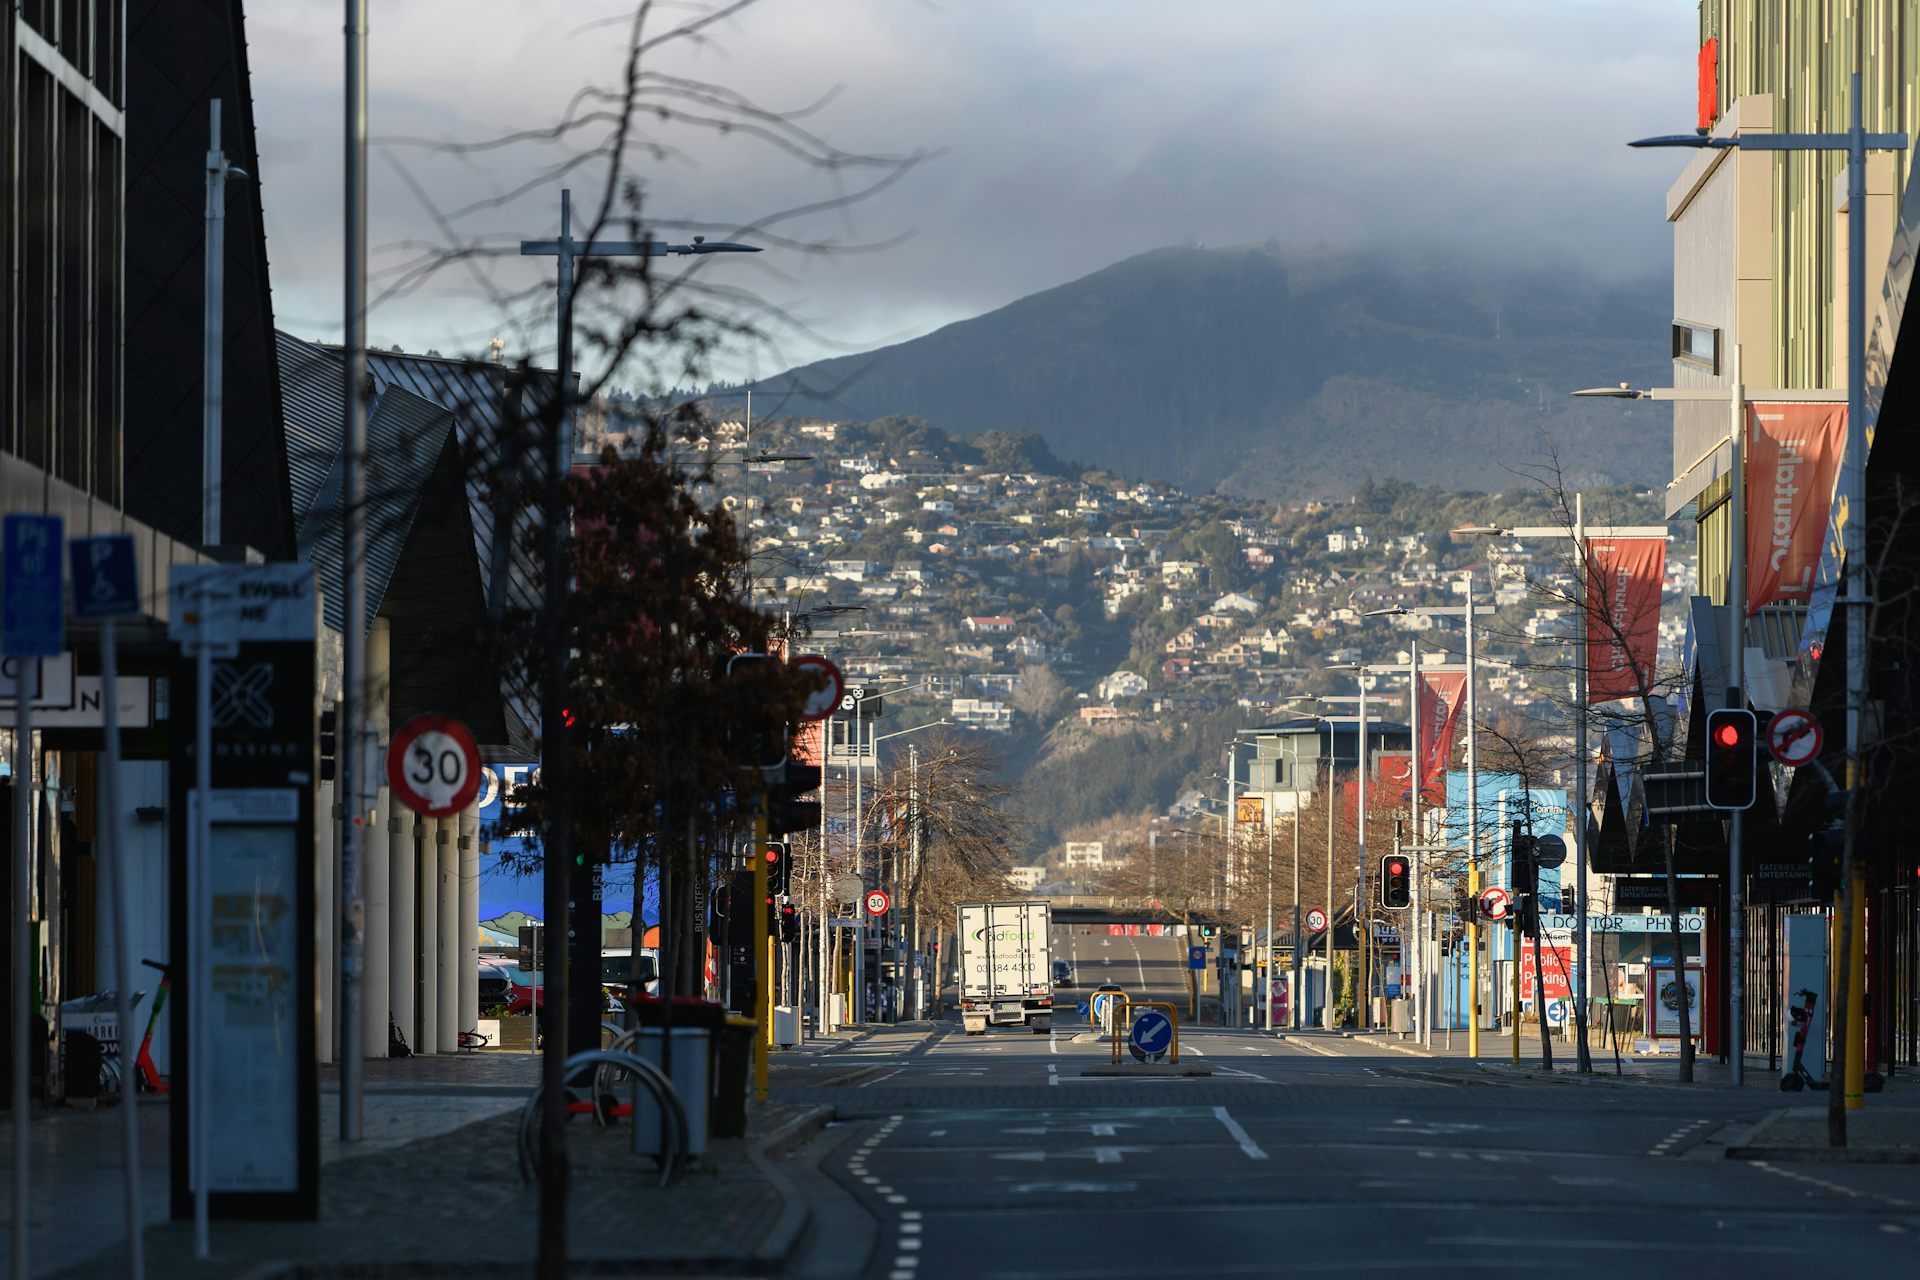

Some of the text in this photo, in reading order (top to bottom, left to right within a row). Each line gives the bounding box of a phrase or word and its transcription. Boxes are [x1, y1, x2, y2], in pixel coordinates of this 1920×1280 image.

[184, 743, 299, 756] COSSING
[412, 749, 461, 785] 30
[870, 898, 883, 908] 30
[695, 913, 703, 933] BUS
[1310, 915, 1322, 926] 30
[1553, 917, 1623, 930] DOTOR
[976, 963, 1035, 973] 03 384 4300
[1524, 971, 1567, 987] Pking
